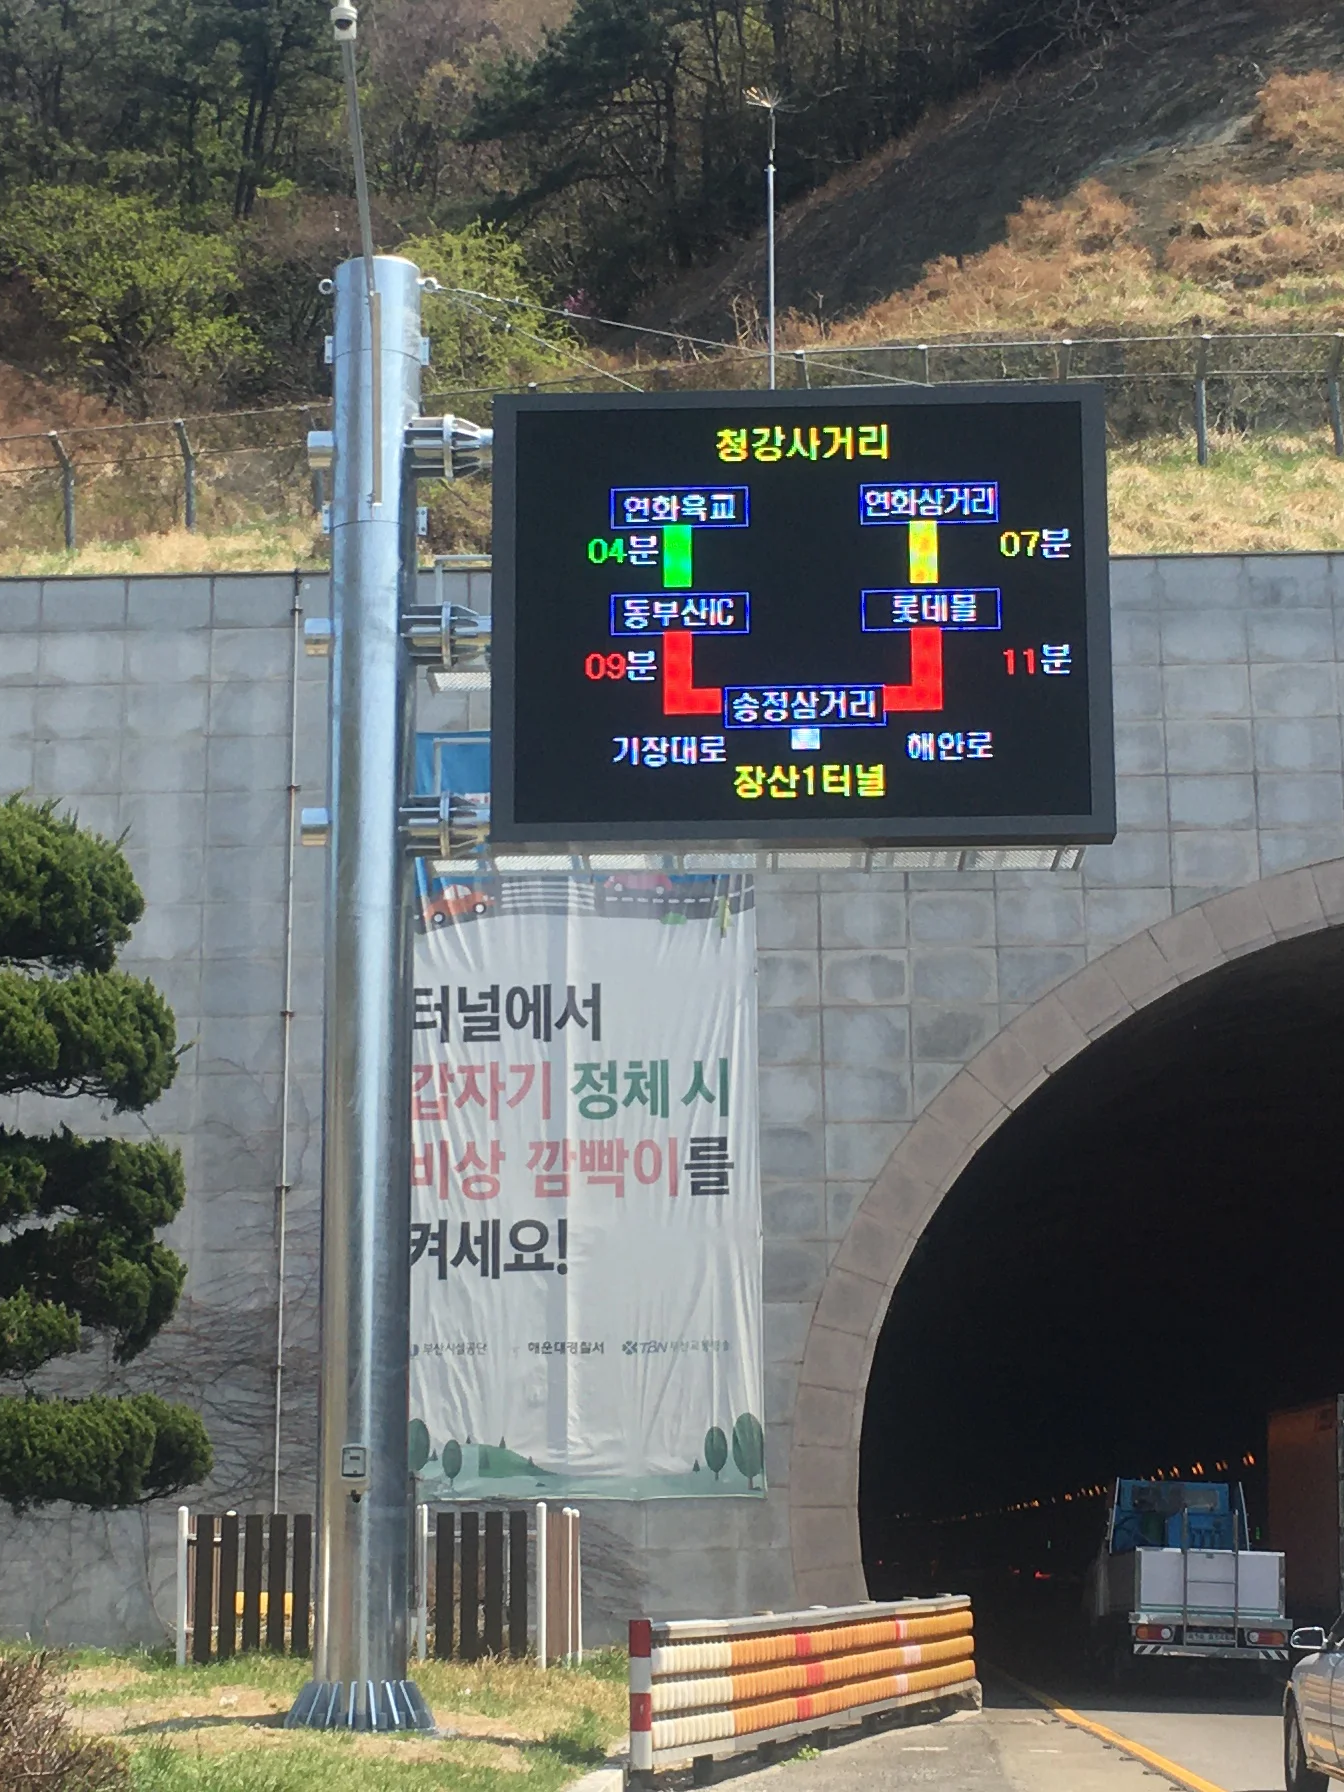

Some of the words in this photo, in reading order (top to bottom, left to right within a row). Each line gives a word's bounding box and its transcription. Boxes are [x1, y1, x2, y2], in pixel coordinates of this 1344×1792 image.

[716, 424, 890, 462] 청강사거리
[623, 493, 737, 522] 연화육교
[864, 486, 996, 516] 연화삼거리
[587, 535, 659, 564] 04분
[999, 528, 1072, 559] 07분
[623, 598, 735, 629] 동부산IC
[891, 593, 977, 623] 롯데몰
[584, 650, 658, 681] 09분
[1002, 643, 1072, 675] 11분
[731, 689, 877, 723] 송정삼거리
[612, 735, 728, 768] 기장대로
[906, 730, 995, 761] 해안로
[733, 763, 887, 799] 장산1터널
[412, 982, 602, 1044] 터널에서
[412, 1060, 552, 1121] 갑자기
[570, 1058, 670, 1121] 정체
[680, 1057, 730, 1118] 시
[411, 1139, 506, 1201] 비상
[525, 1136, 735, 1199] 깜빡이를
[410, 1217, 568, 1281] 켜세요!
[527, 1340, 605, 1356] 해운대경찰서
